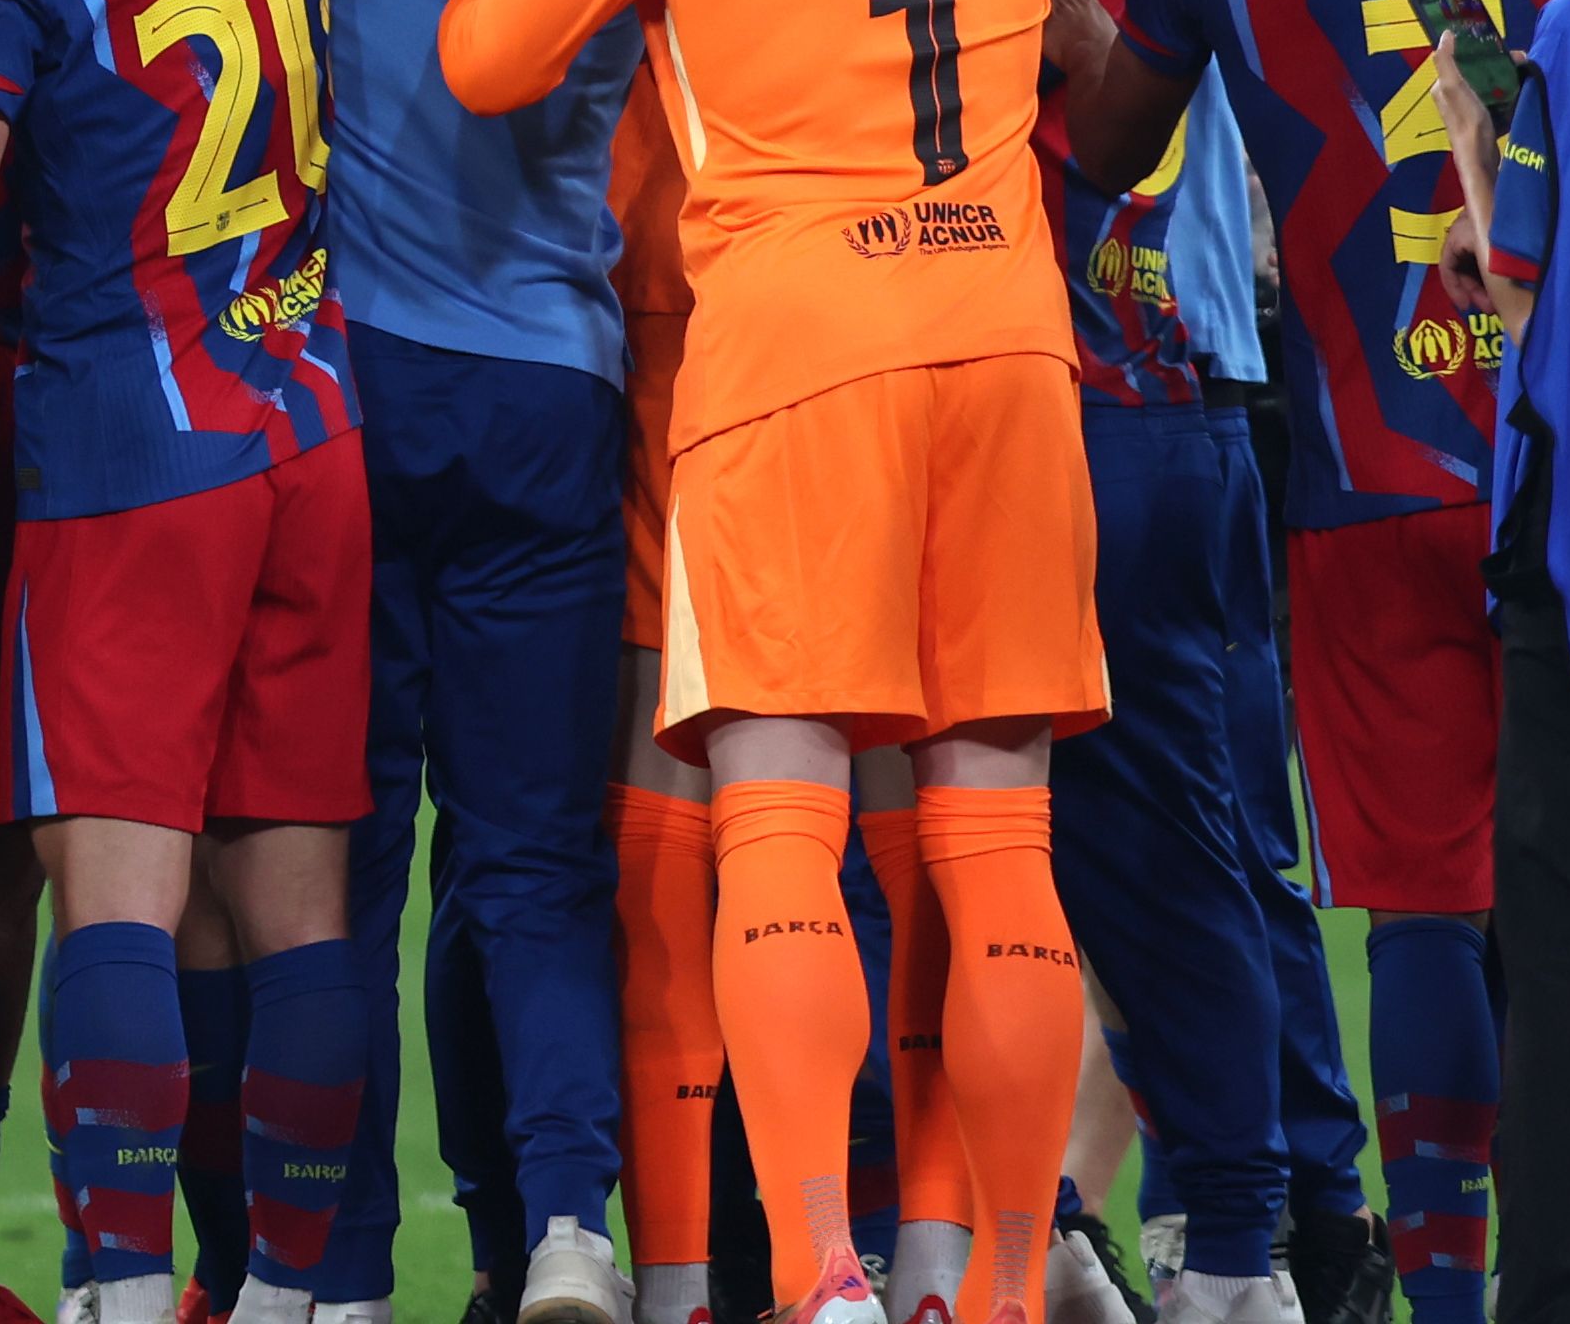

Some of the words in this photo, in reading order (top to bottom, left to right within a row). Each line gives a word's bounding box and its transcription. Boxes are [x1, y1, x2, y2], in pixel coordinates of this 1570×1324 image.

[913, 202, 997, 224] UNHCR
[918, 225, 1006, 246] ACNUR
[744, 920, 844, 944] BARÇA
[986, 943, 1076, 968] BARÇA
[117, 1147, 177, 1167] BARÇ
